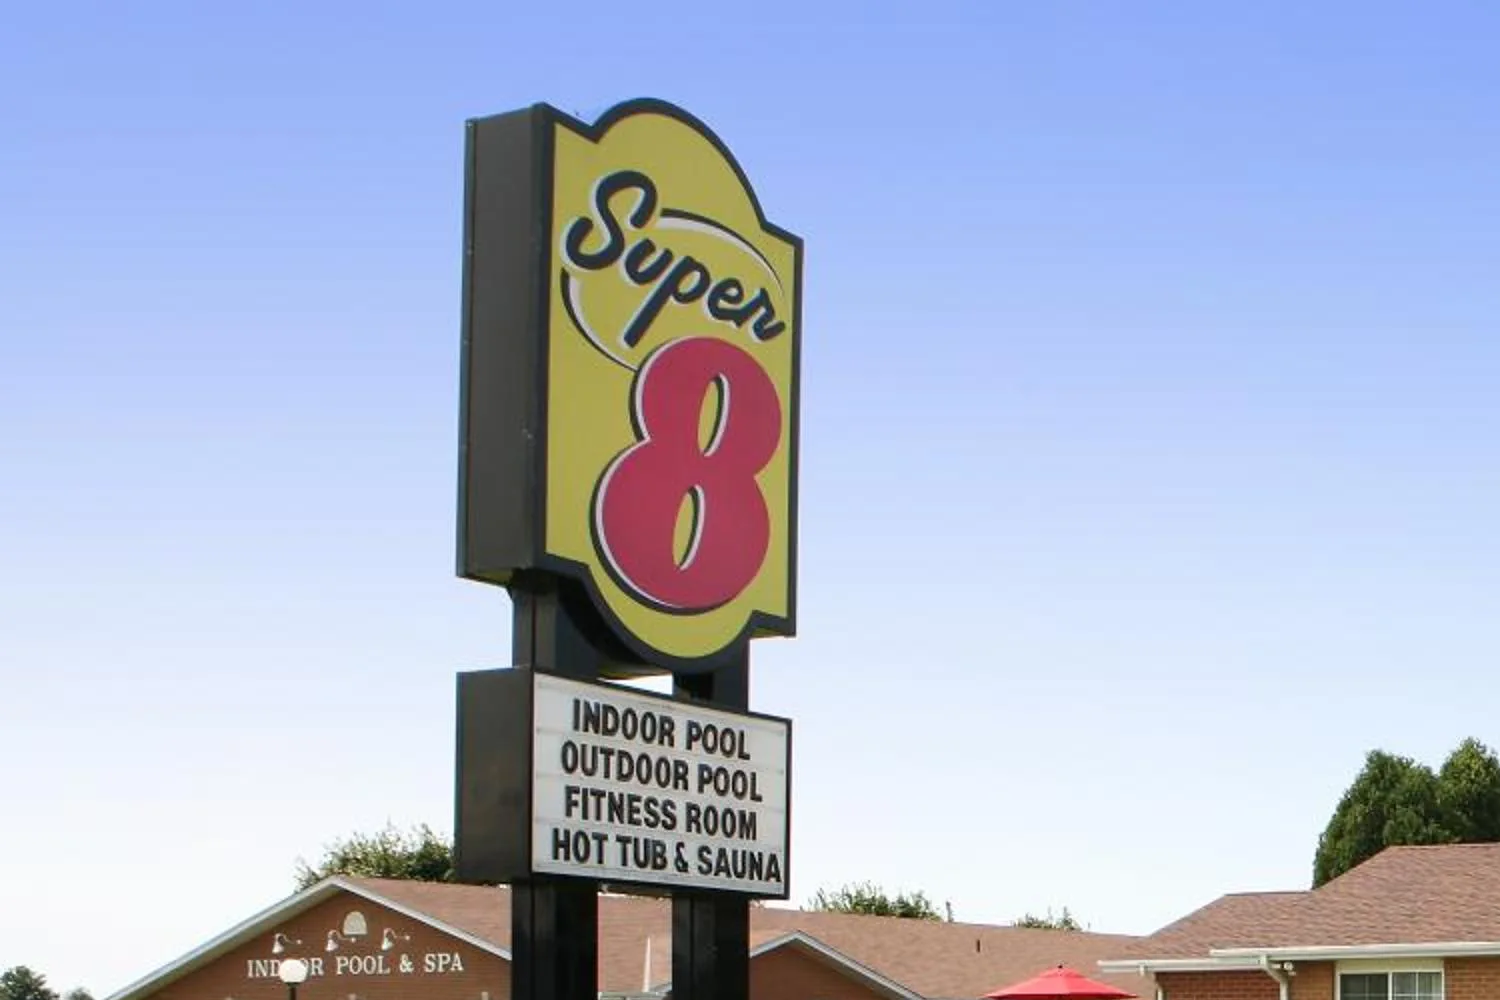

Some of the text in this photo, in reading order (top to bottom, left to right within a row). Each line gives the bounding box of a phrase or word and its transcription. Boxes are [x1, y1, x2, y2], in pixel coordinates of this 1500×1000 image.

[563, 170, 786, 349] Super
[589, 335, 782, 616] 8
[572, 698, 751, 761] INDOOR POOL
[561, 740, 763, 802] OUTDOOR POOL
[564, 785, 757, 841] FITNESS ROOM
[552, 828, 782, 883] HOT TUB & SAUNA
[247, 952, 464, 978] INDR POOL & SPA
